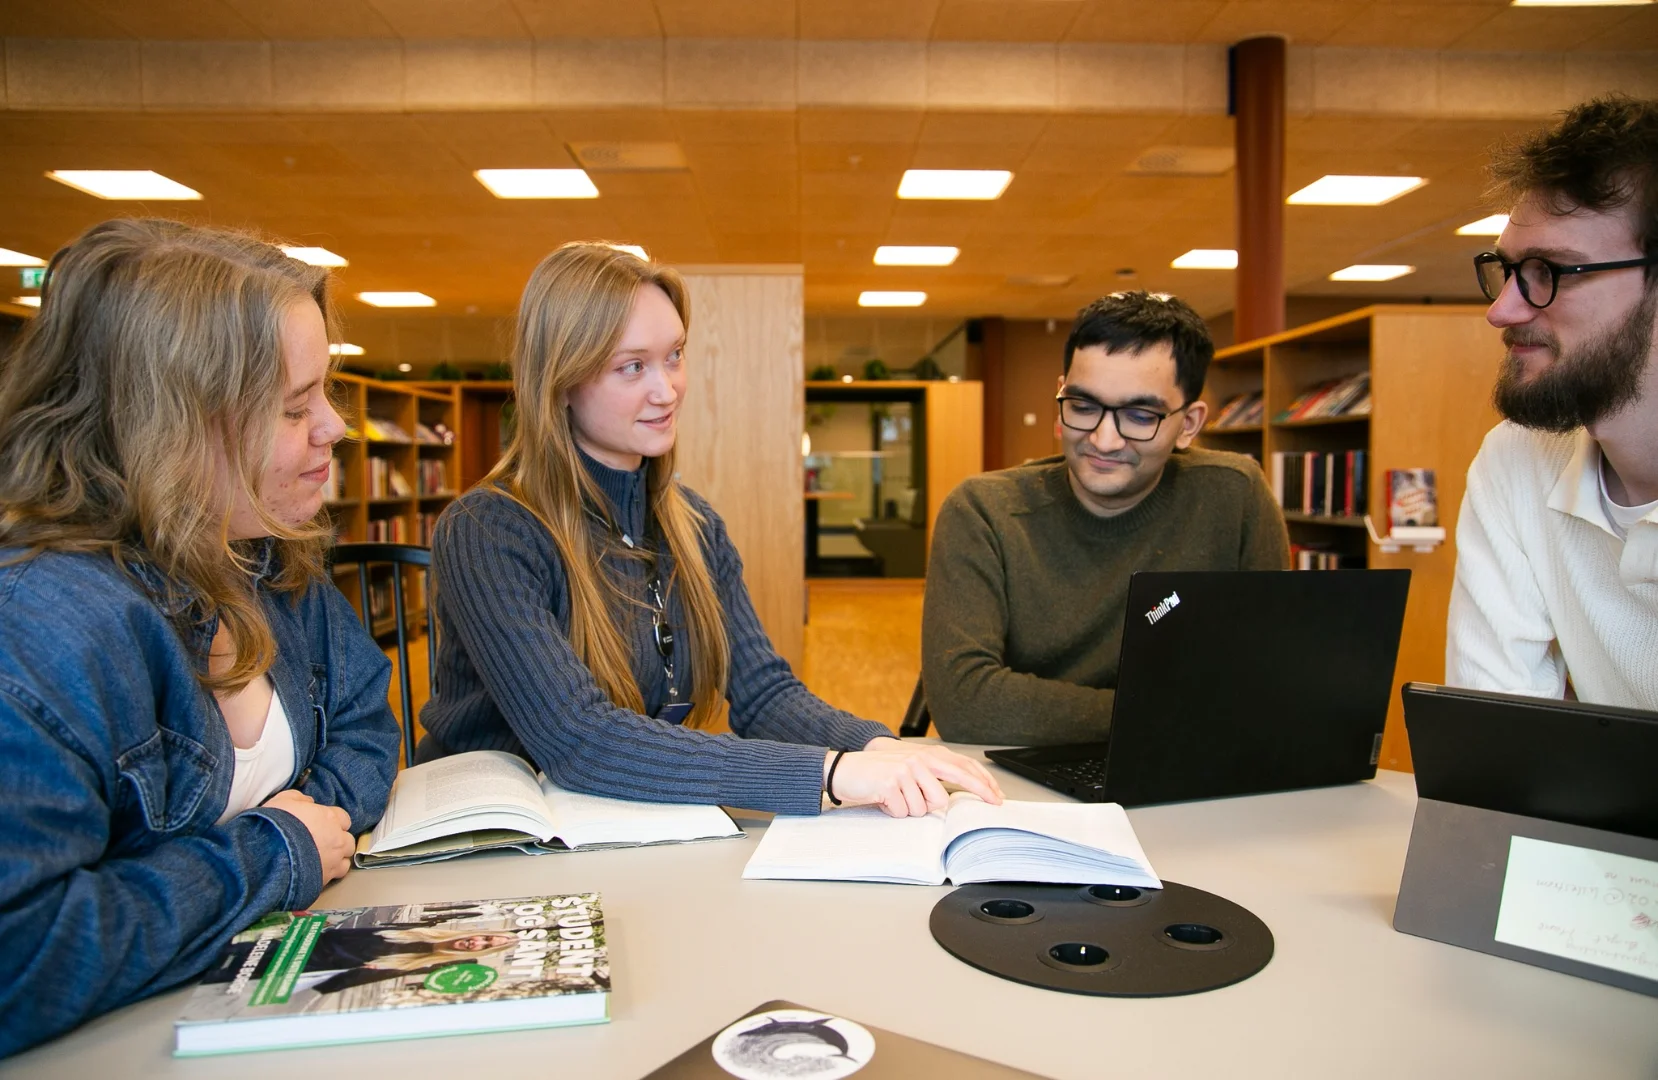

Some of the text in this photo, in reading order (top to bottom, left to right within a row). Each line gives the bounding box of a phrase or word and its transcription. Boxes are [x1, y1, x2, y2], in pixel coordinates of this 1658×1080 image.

[1145, 591, 1180, 625] ThinkPad
[514, 904, 546, 928] OG
[552, 896, 595, 978] STUDENT
